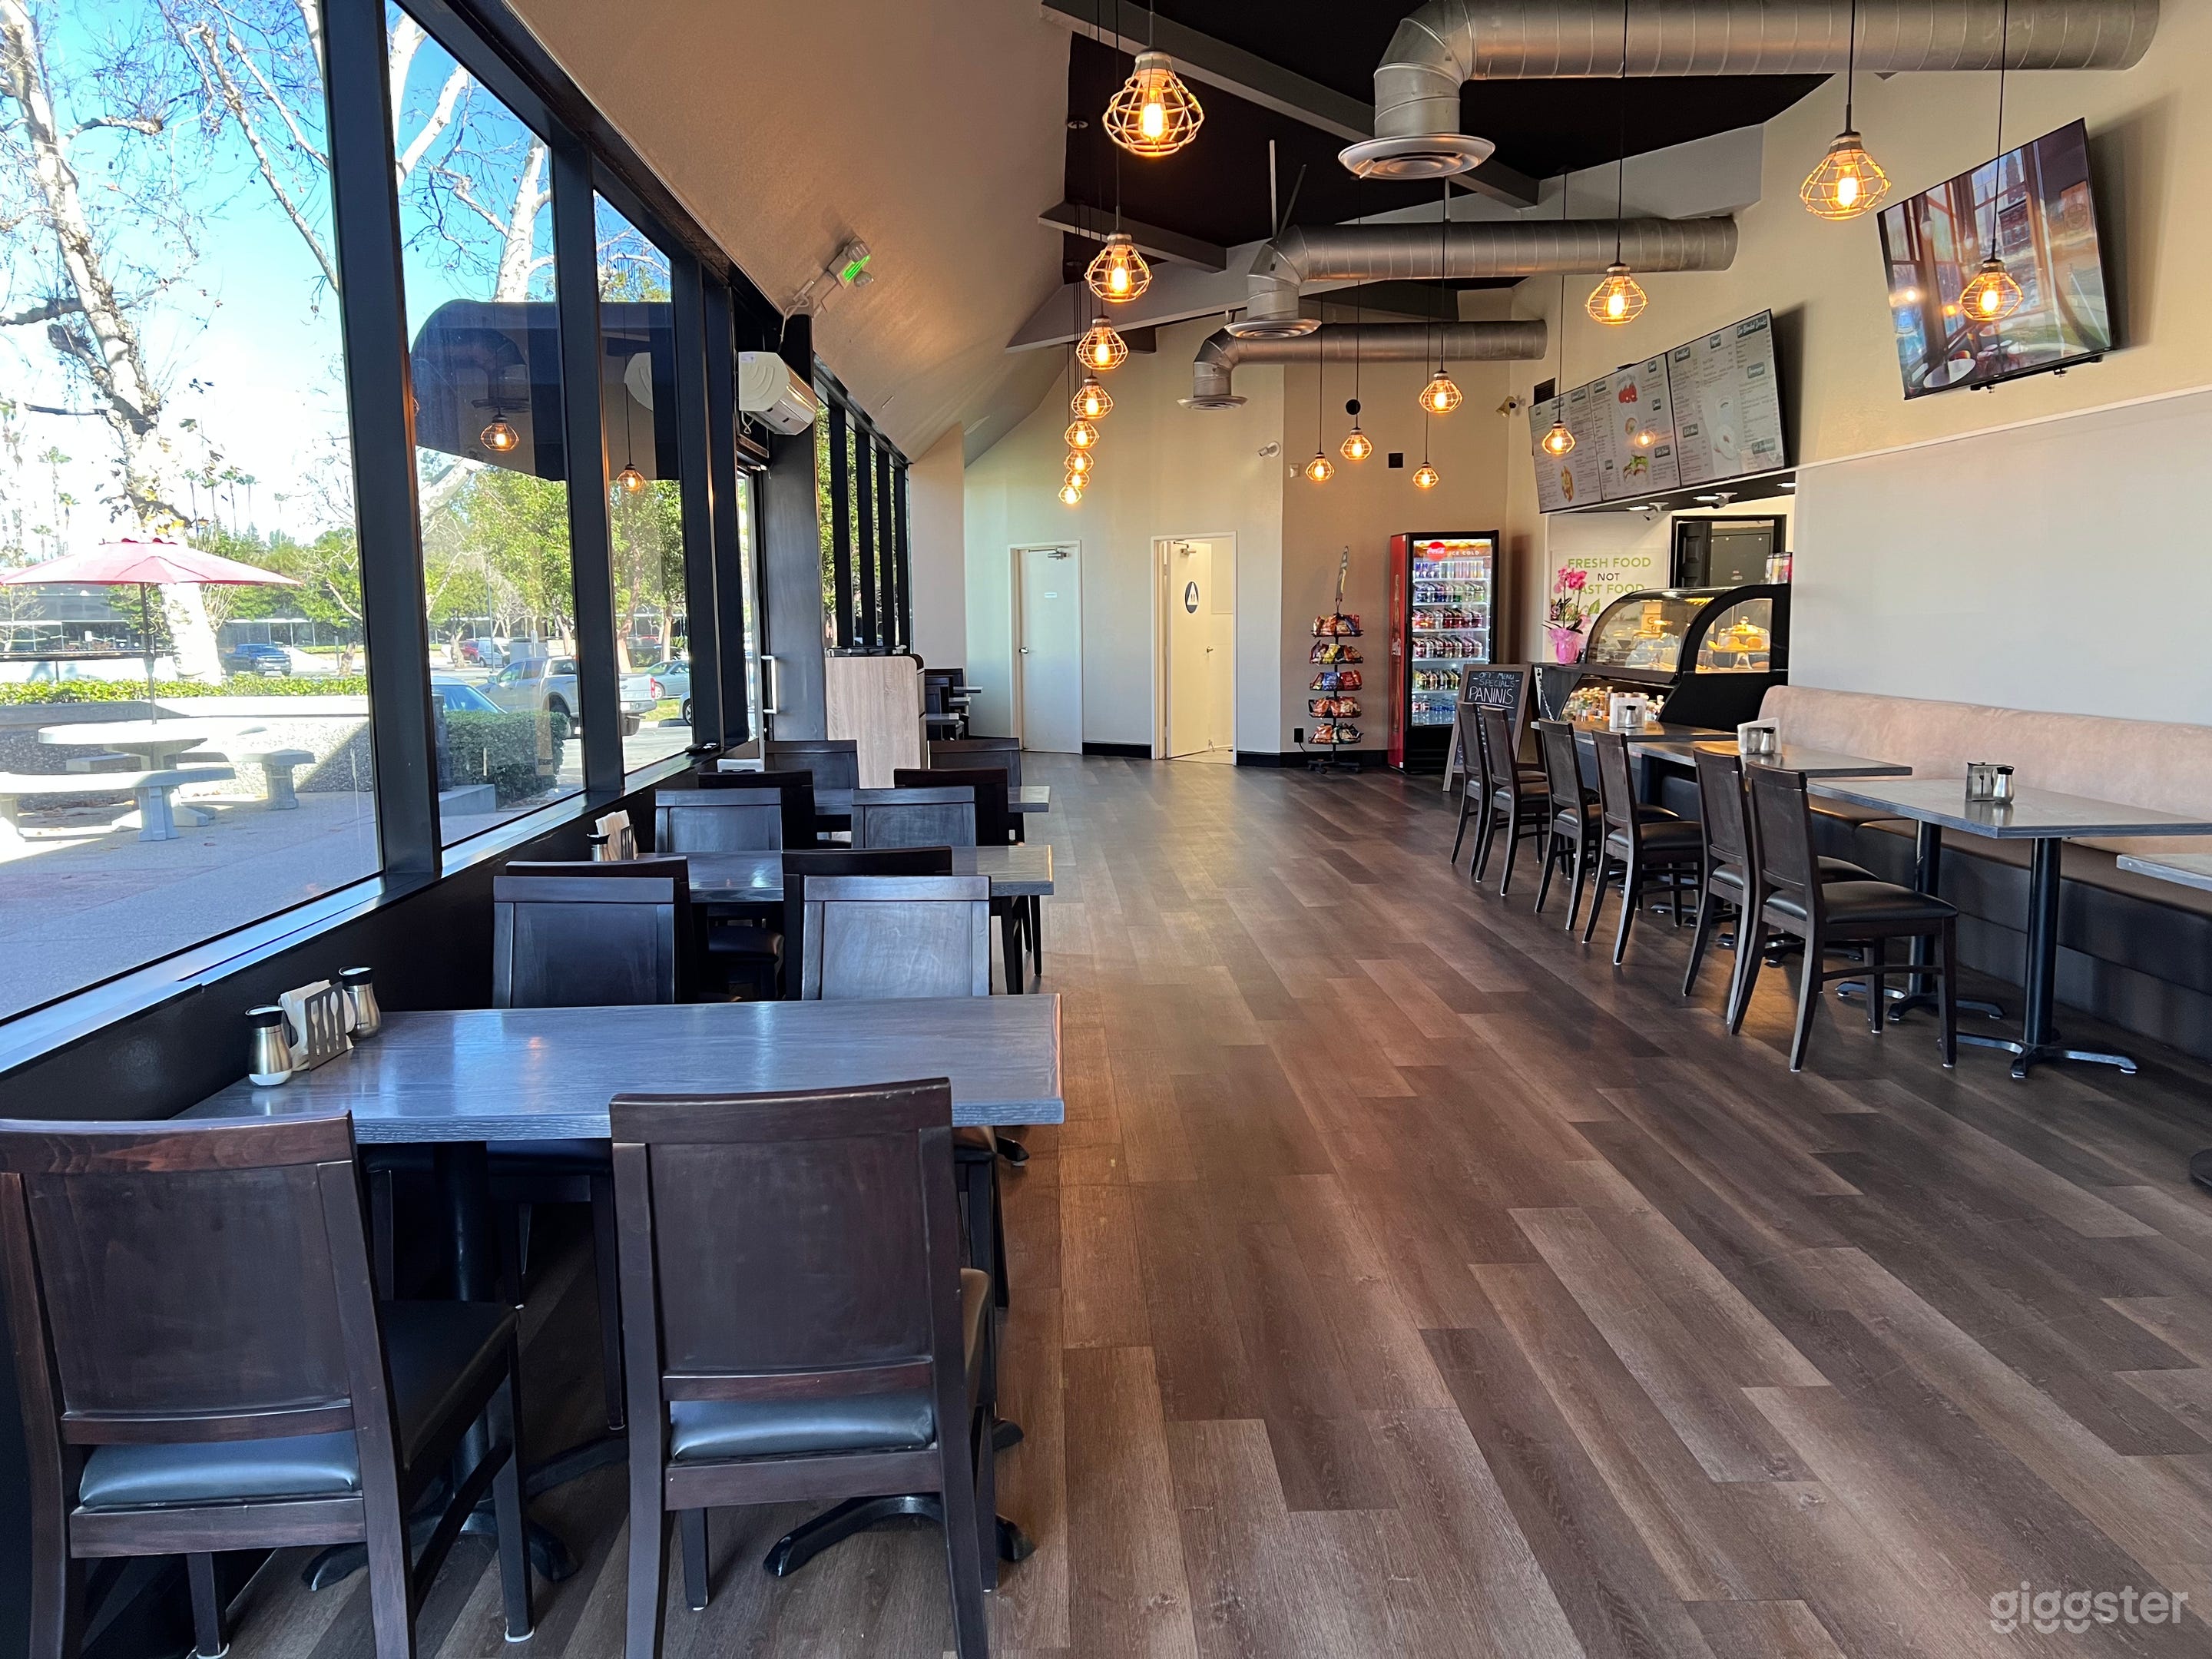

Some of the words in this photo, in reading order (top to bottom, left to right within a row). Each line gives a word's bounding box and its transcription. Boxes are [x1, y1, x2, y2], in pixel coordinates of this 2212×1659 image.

[1568, 558, 1608, 568] FRESH
[1613, 557, 1651, 568] FOOD
[1598, 572, 1621, 581] NOT
[1479, 679, 1516, 688] SPECIALS
[1469, 686, 1515, 705] PANINIS
